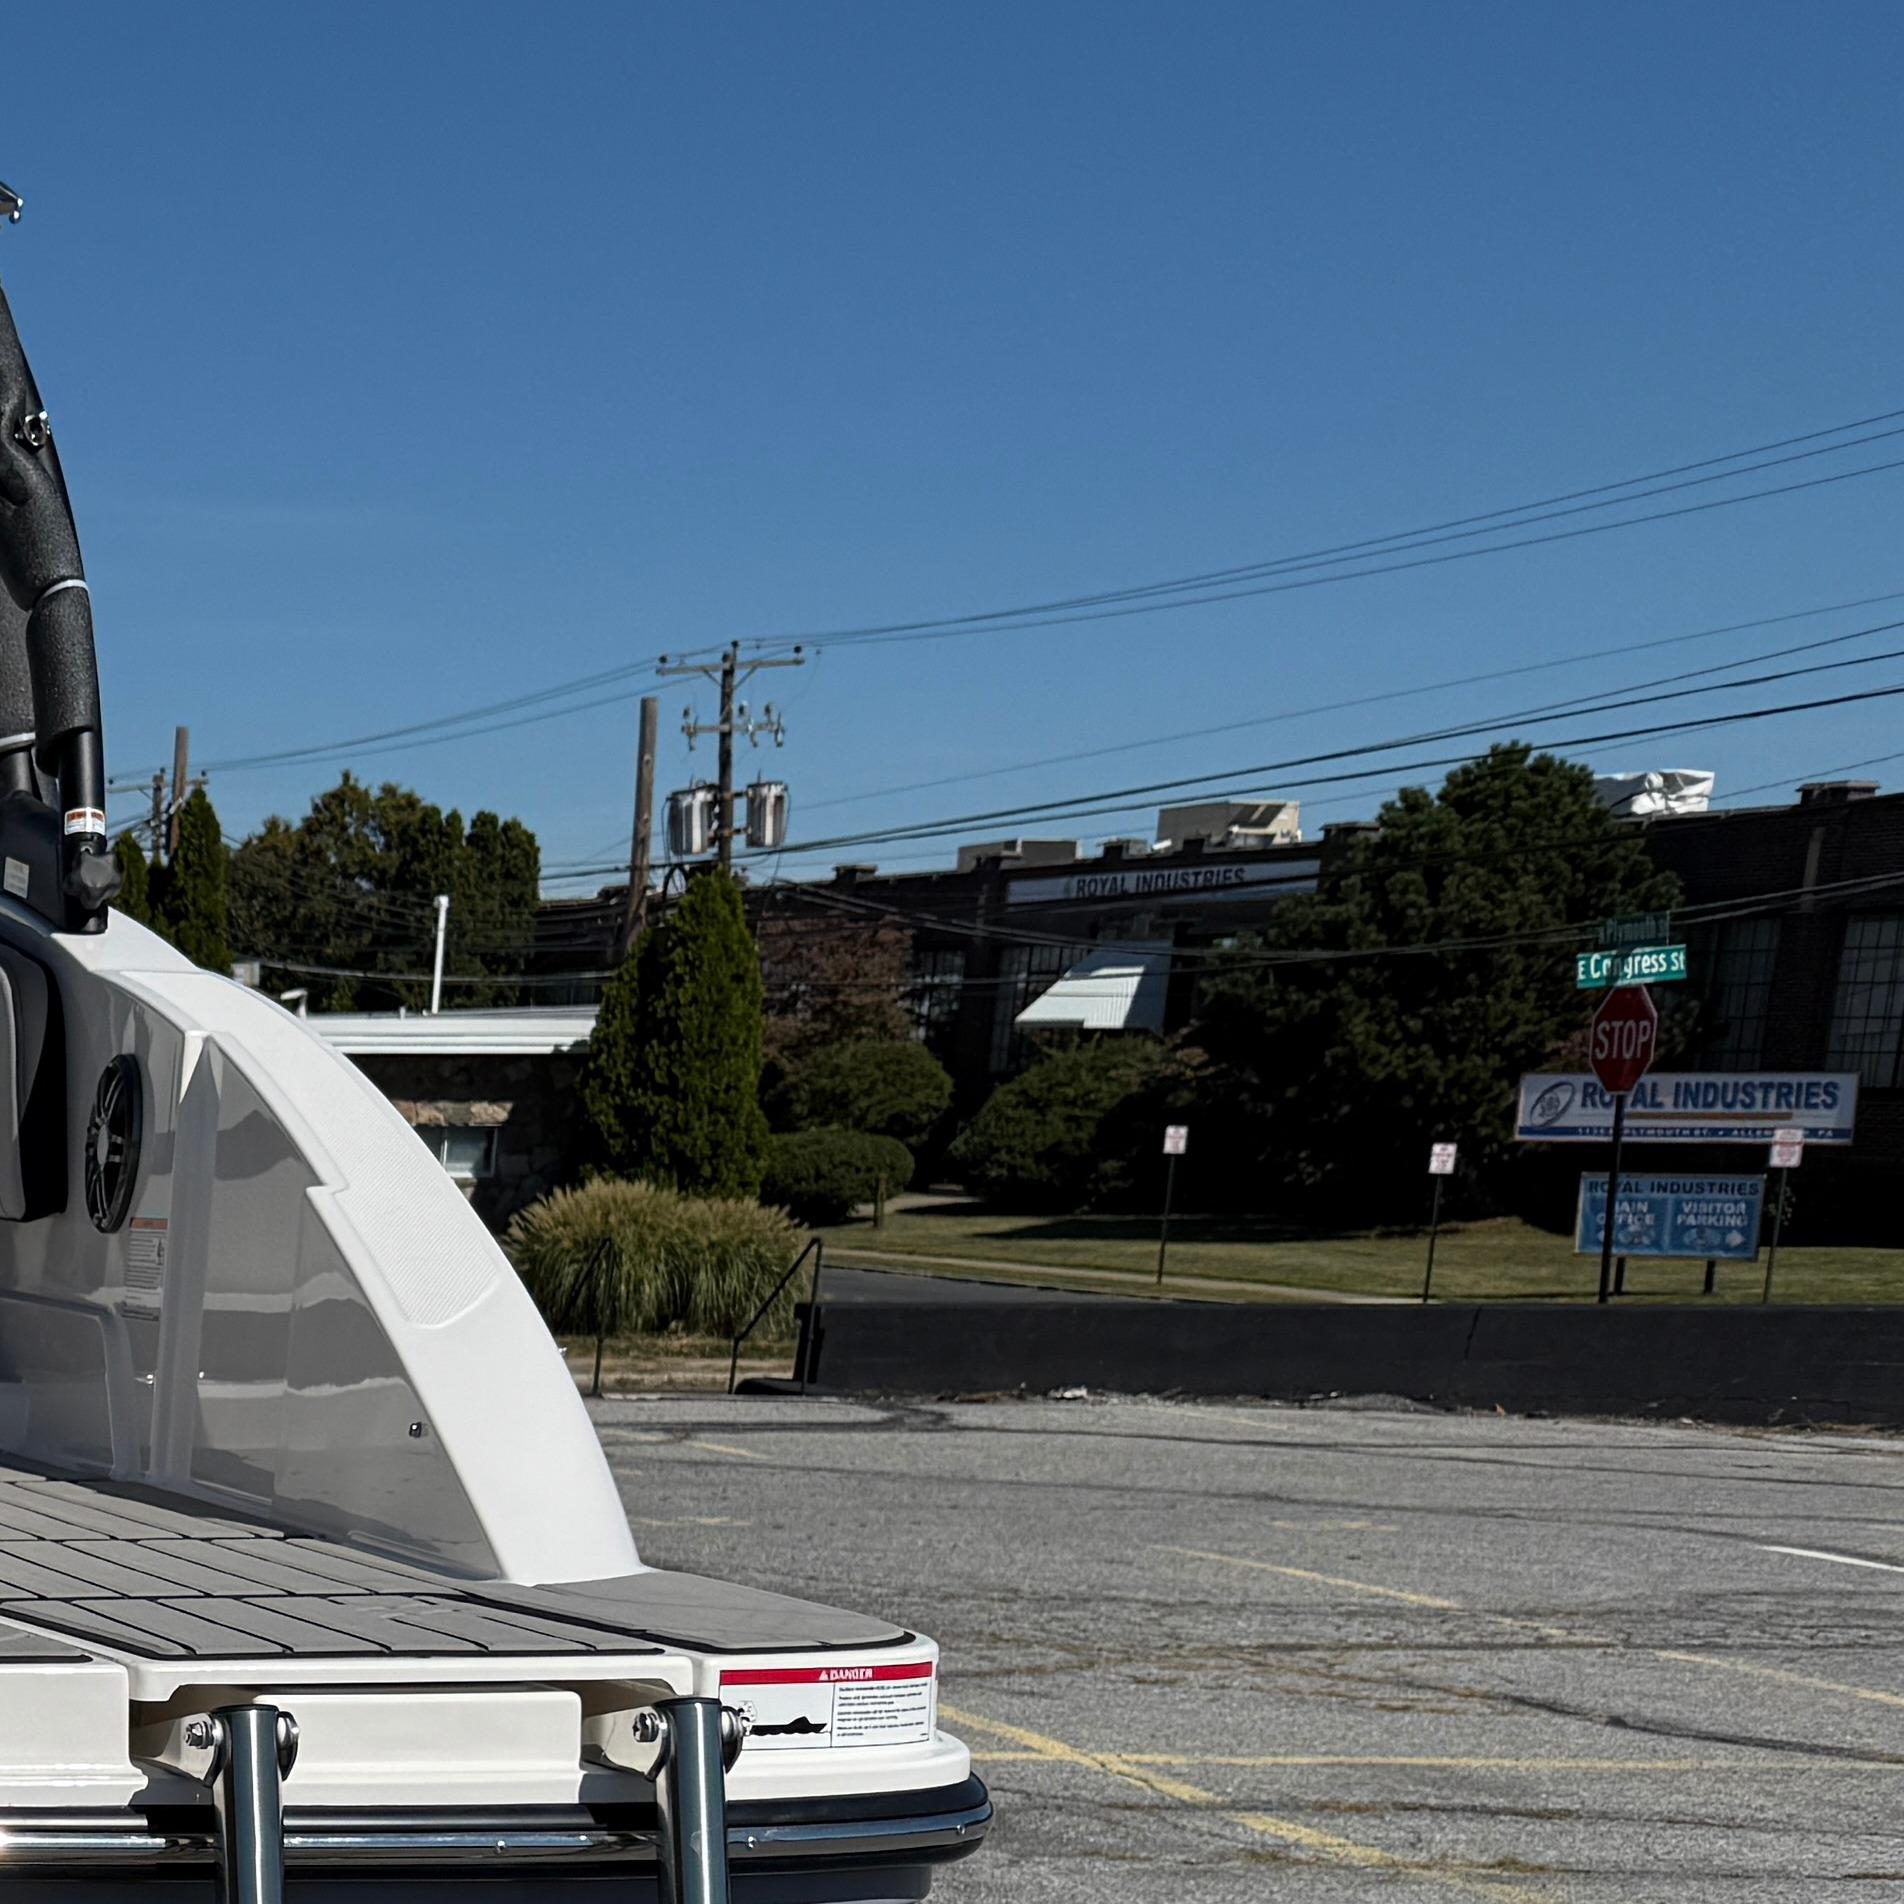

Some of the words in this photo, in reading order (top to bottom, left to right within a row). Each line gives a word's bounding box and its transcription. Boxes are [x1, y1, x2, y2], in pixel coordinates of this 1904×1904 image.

[1076, 875, 1131, 900] ROYAL
[1136, 867, 1246, 894] INDUSTRIES
[1578, 960, 1587, 980] E
[1589, 953, 1667, 980] Congress
[1670, 950, 1685, 971] St
[1595, 1019, 1652, 1061] STOP
[1581, 1081, 1664, 1110] ROAL
[1673, 1081, 1840, 1109] INDUSTRIES
[1651, 1181, 1760, 1195] INDUSTRIES
[1682, 1202, 1747, 1215] VISITOR
[1596, 1214, 1656, 1226] OFICE
[1677, 1214, 1749, 1227] PARKING
